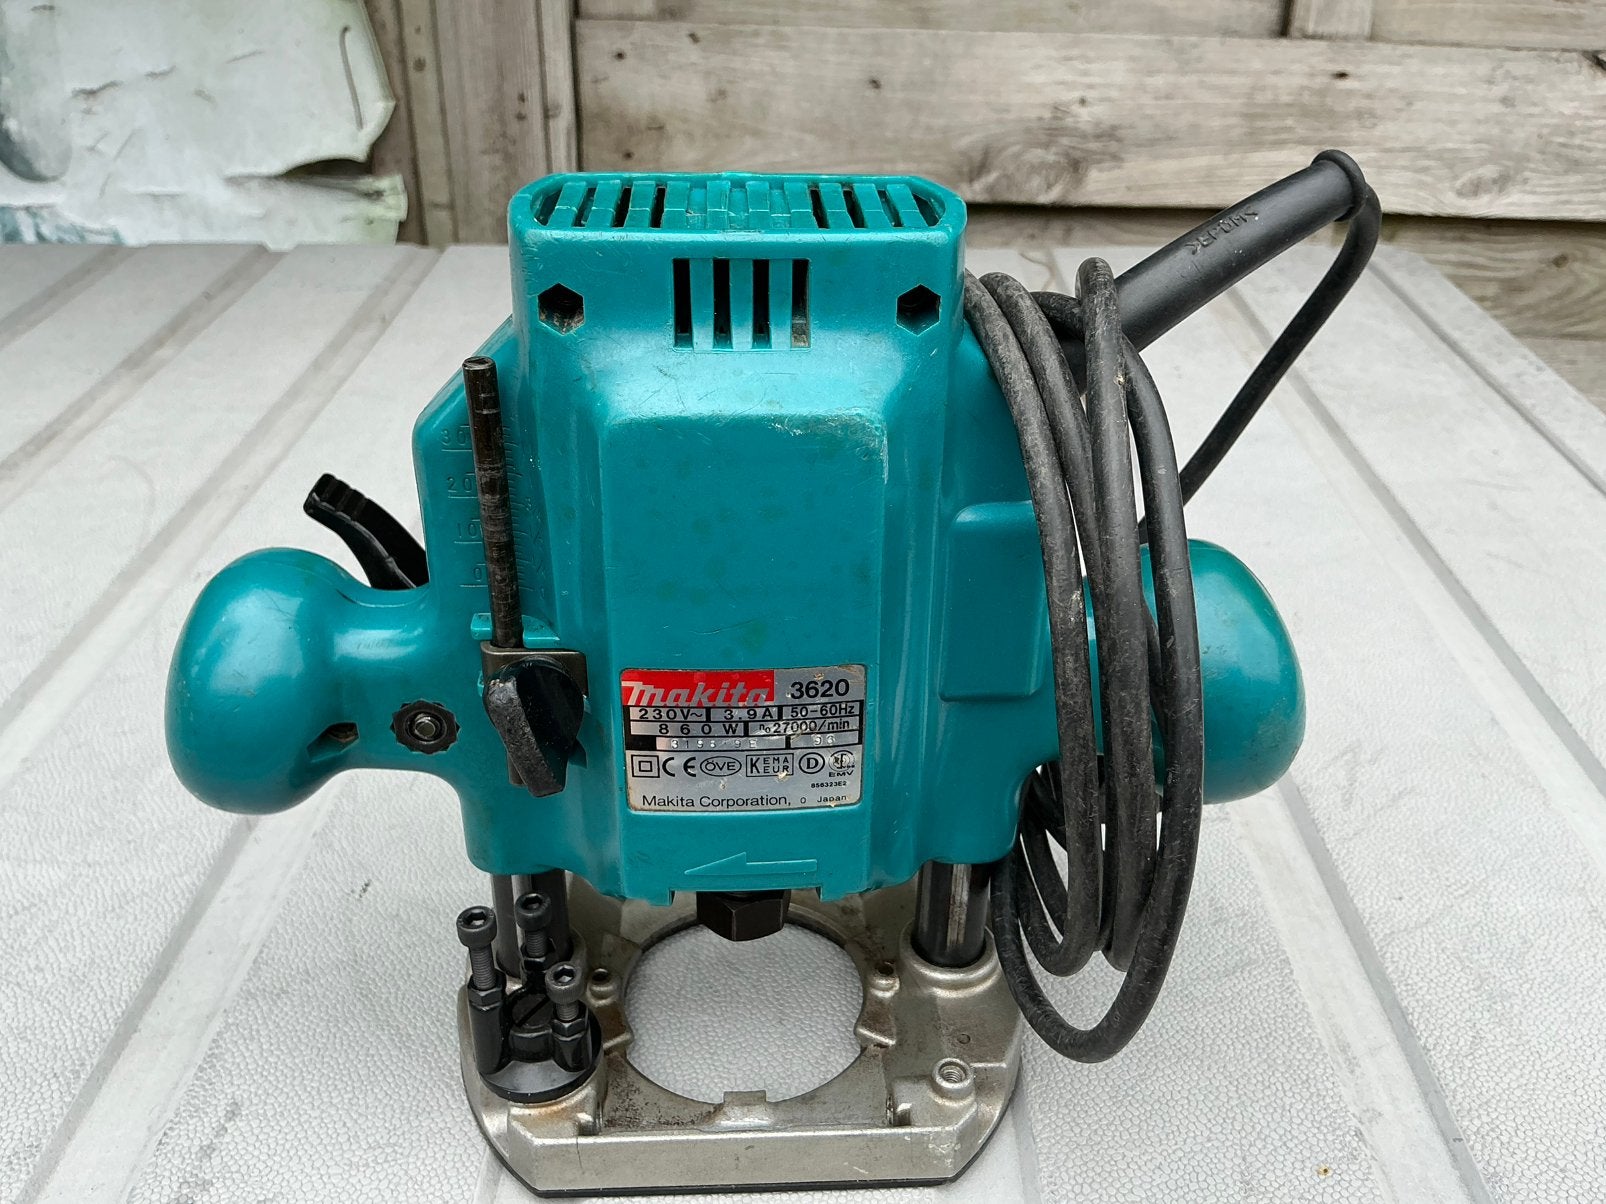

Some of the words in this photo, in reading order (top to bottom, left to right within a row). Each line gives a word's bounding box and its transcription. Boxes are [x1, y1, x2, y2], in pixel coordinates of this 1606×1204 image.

[790, 679, 850, 699] 3620
[790, 704, 855, 718] 50-60Hz
[829, 770, 854, 778] EMV
[642, 795, 695, 808] Makita
[699, 794, 792, 809] Corporation,
[817, 794, 847, 804] Japan
